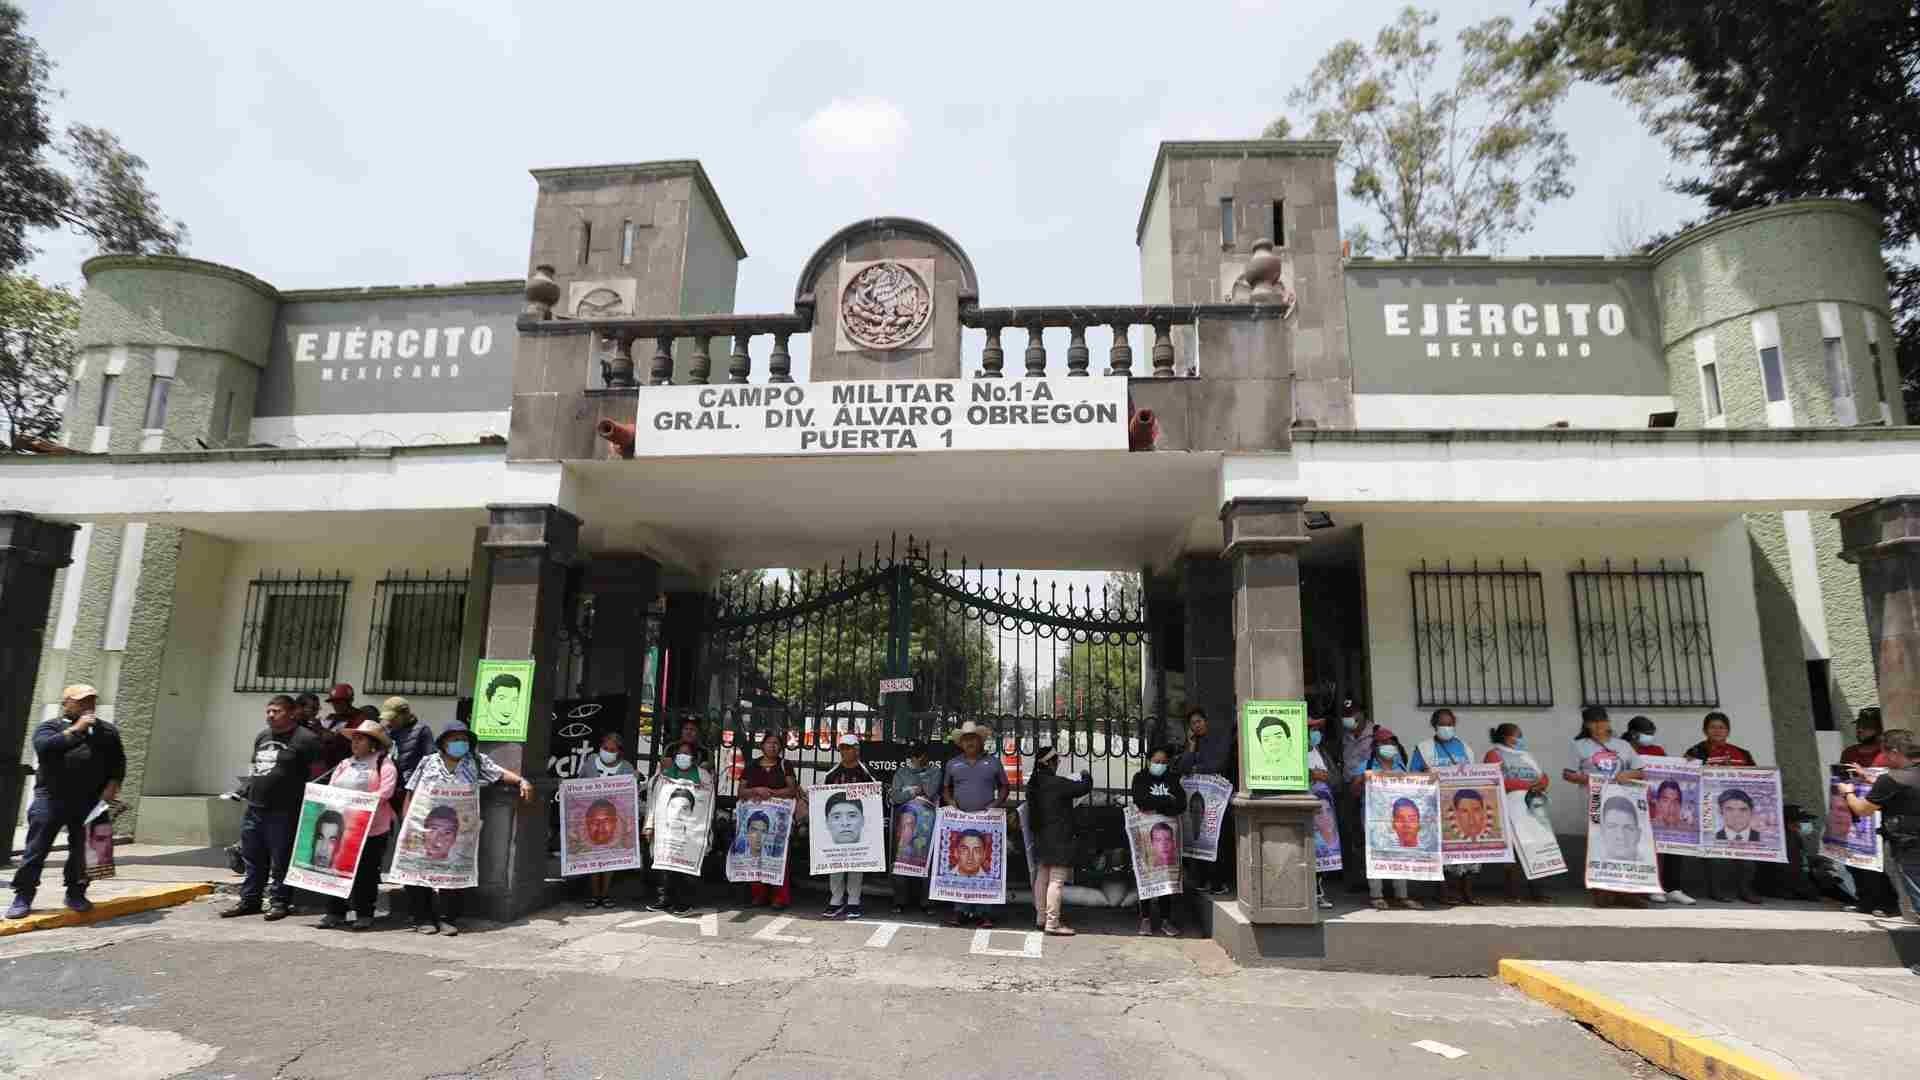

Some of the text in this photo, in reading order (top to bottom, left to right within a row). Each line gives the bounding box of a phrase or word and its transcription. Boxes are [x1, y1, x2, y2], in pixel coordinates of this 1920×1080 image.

[1383, 297, 1625, 336] EJÉRCITO
[295, 326, 493, 361] EJÉRCITO
[1426, 342, 1591, 357] MEXICANO
[321, 364, 459, 381] MEXICANO
[698, 386, 805, 409] CAMPO
[832, 382, 955, 404] MILITAR
[653, 399, 1117, 431] GRAL. DIV. ÁLVARO OBREGÓN
[800, 429, 954, 450] PUERTA 1
